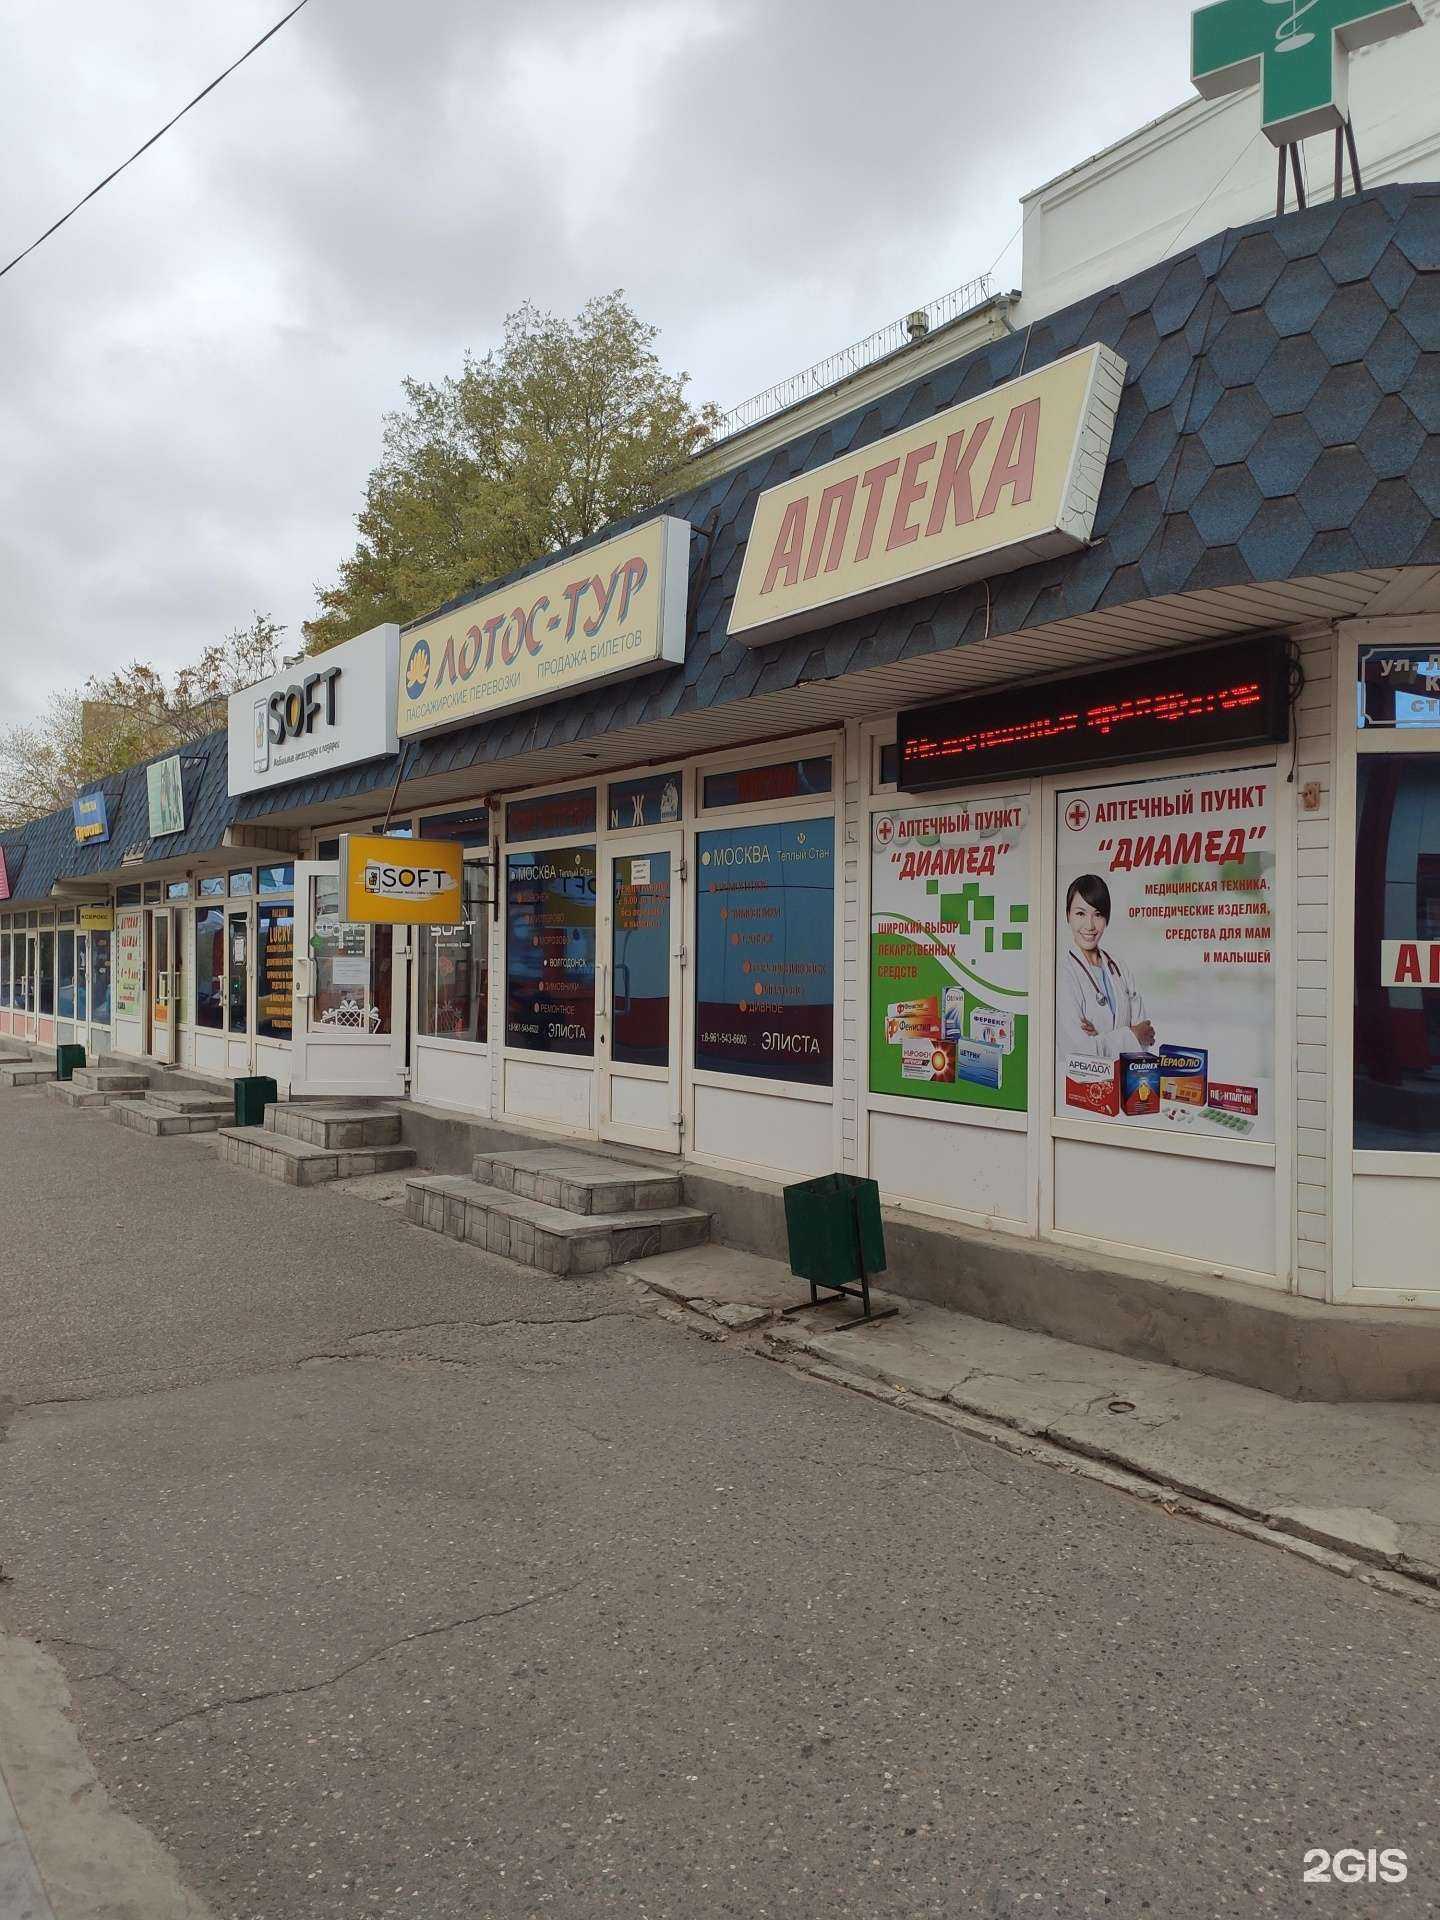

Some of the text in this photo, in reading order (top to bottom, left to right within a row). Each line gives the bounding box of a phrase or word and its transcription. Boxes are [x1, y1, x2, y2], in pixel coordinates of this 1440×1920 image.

[760, 397, 1041, 595] АПТЕКА
[434, 556, 648, 690] ЛОТОС-ТУР
[406, 630, 642, 721] ПАССАЖИРСКИЕ ПЕРЕВОЗКИ ПРОДАЖА БИЛЕТОВ
[267, 666, 342, 745] SOFT
[1095, 785, 1266, 823] АПТЕЧНЫЙ ПУНКТ
[898, 808, 1022, 838] АПТЕЧНЫЙ ПУНКТ
[713, 845, 771, 866] МОСКВА
[1098, 826, 1267, 873] “ДИАМЕД”
[518, 864, 557, 882] МОСКВА
[891, 844, 1010, 881] “ДИАМЕД”
[382, 868, 447, 889] SOFT
[1145, 878, 1271, 896] МЕДИЦИНСКАЯ ТЕХНИКА,
[1129, 903, 1271, 919] ОРТОПЕДИЧЕСКИЕ ИЗДЕЛИЯ,
[878, 920, 959, 934] ШИРОКИЙ ВЫБОР
[1165, 928, 1271, 941] СРЕДСТВА ДЛЯ МАМ
[878, 944, 957, 956] ЛЕКАРСТВЕННЫХ
[1203, 949, 1271, 963] И МАЛЫШЕЙ
[878, 965, 917, 980] СРЕДСТВ
[548, 1022, 587, 1040] ЭЛИСТА
[761, 1031, 821, 1054] ЭЛИСТА
[1069, 1060, 1111, 1074] АРБИДОЛ
